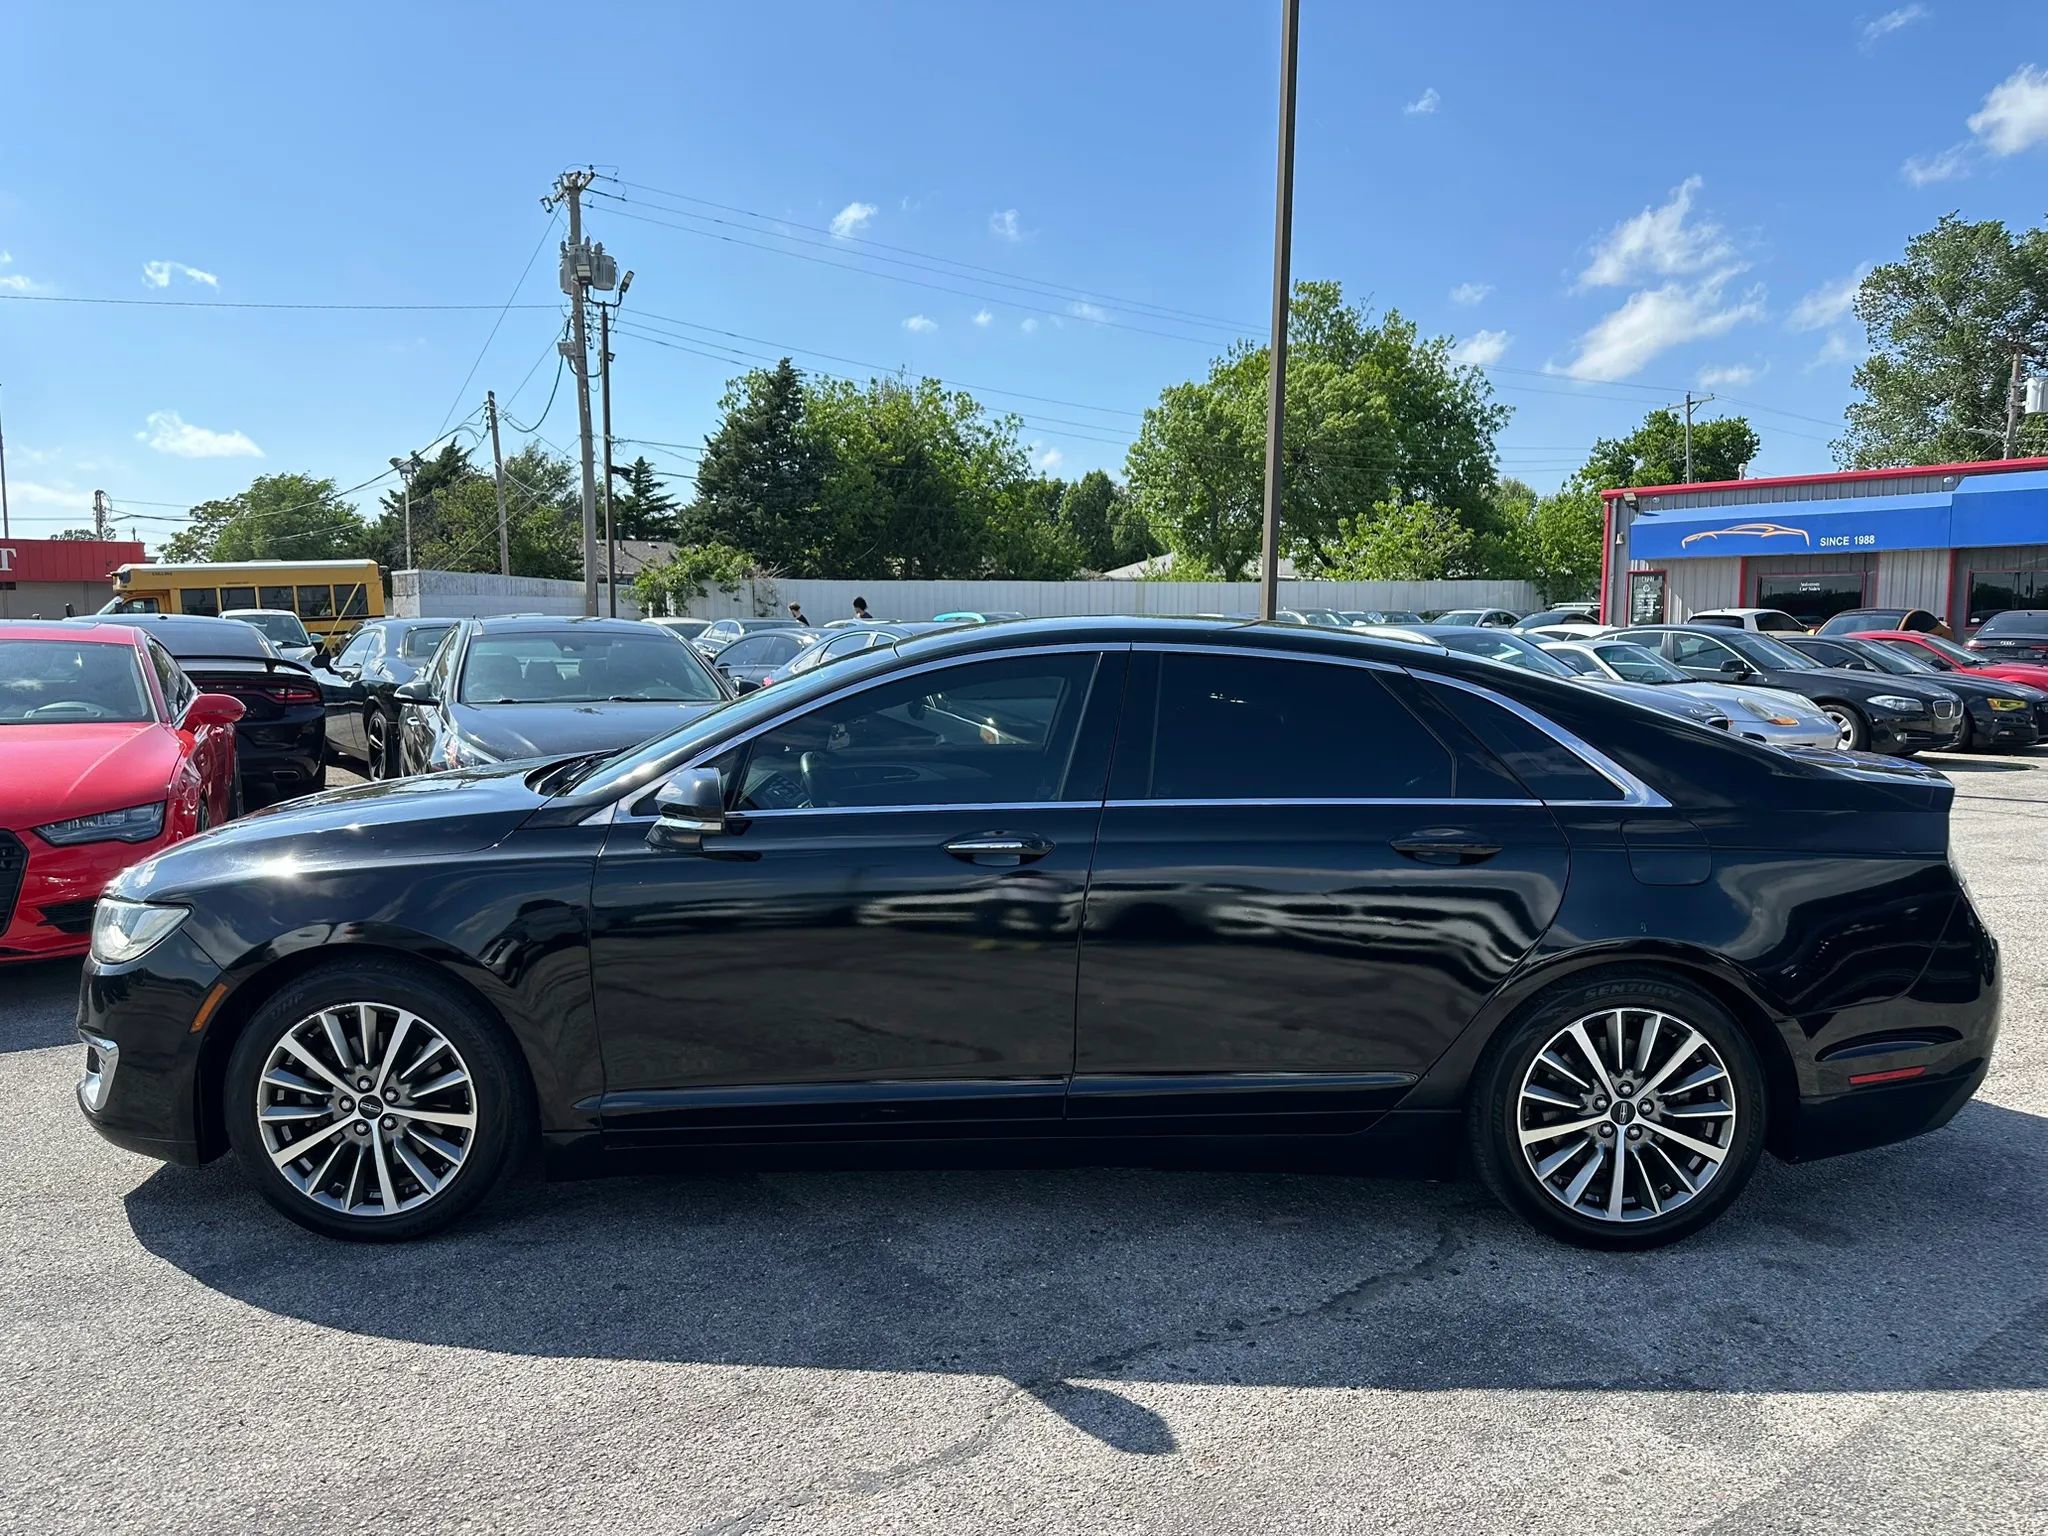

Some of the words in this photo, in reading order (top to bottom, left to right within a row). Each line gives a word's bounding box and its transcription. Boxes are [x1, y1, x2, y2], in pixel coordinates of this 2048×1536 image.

[1819, 535, 1850, 548] SINCE
[1853, 534, 1876, 546] 1988
[1584, 983, 1681, 998] SENTURY
